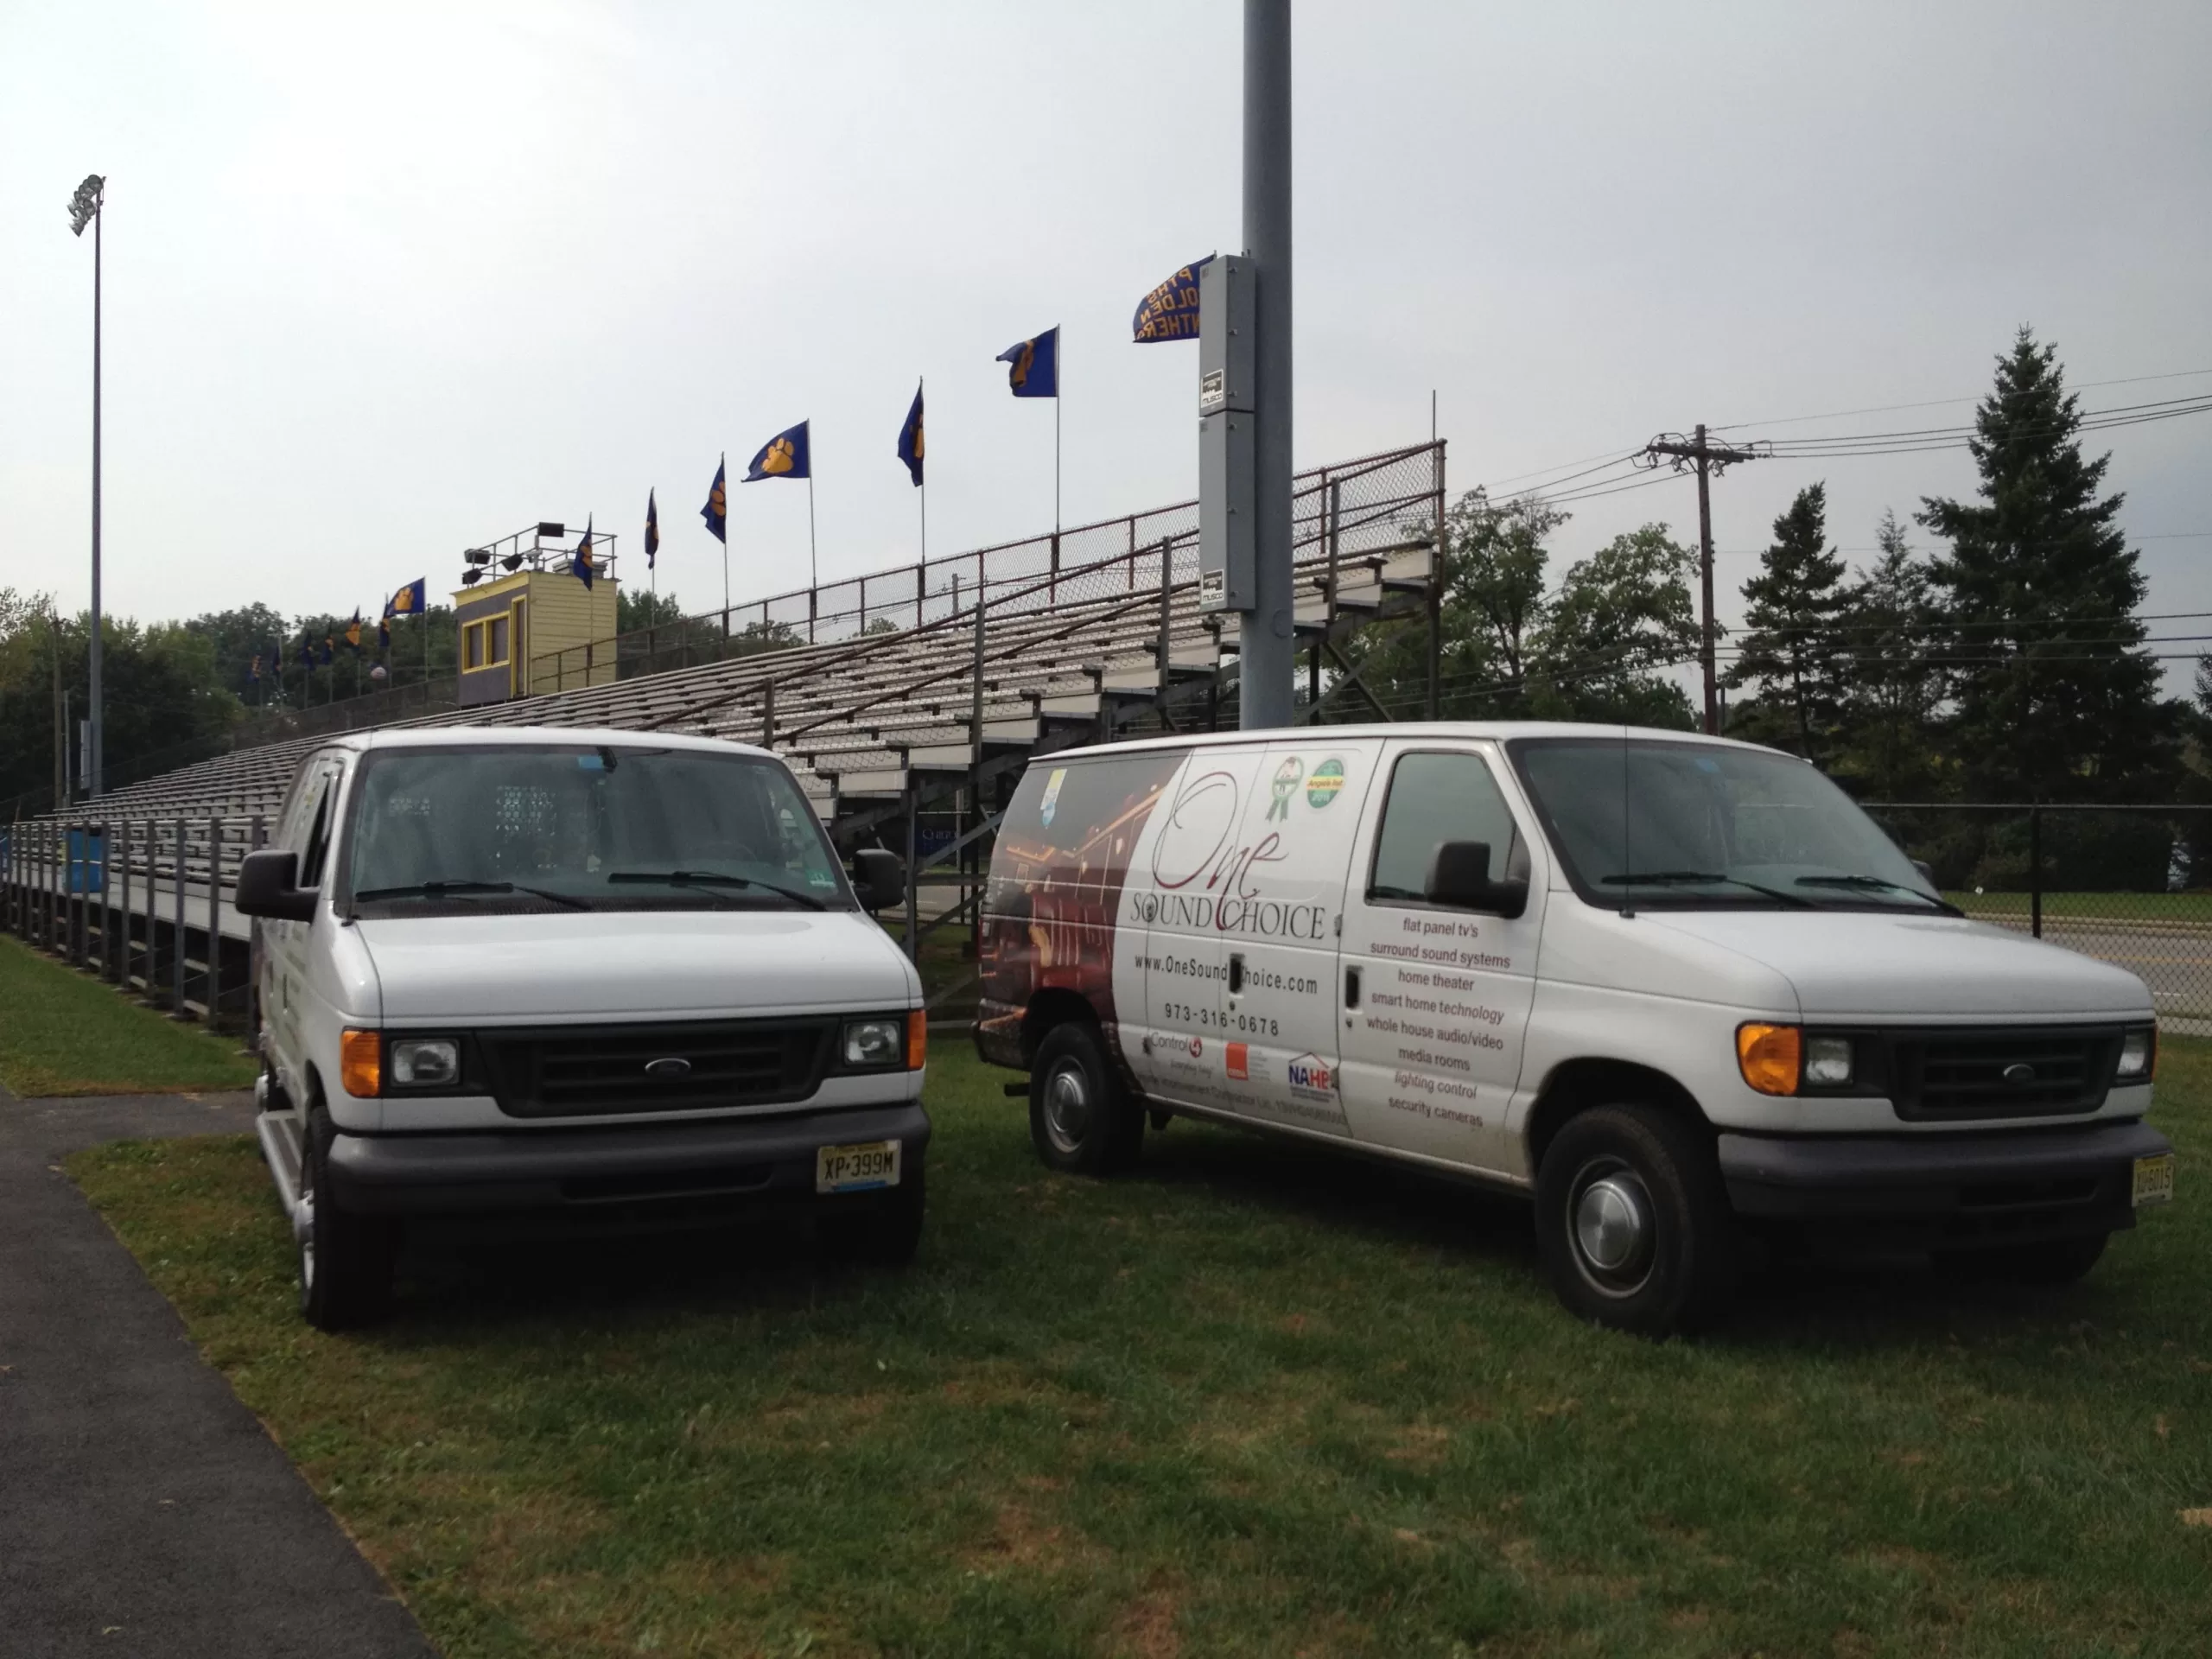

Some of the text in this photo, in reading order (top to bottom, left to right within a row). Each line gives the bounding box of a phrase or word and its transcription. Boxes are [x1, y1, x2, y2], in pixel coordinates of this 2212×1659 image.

[1153, 771, 1289, 931] One
[1130, 893, 1326, 940] SOUND CHOICE
[1403, 917, 1479, 938] flat panel tv's
[1370, 942, 1511, 969] surround sound systems
[1398, 968, 1475, 991] home theater
[1165, 1002, 1279, 1036] 973-316-0678
[1371, 992, 1505, 1026] smart home technology
[1367, 1015, 1504, 1051] whole house audio/video
[1398, 1047, 1471, 1071] media rooms
[1395, 1071, 1478, 1099] lighting control
[1389, 1096, 1484, 1128] security cameras
